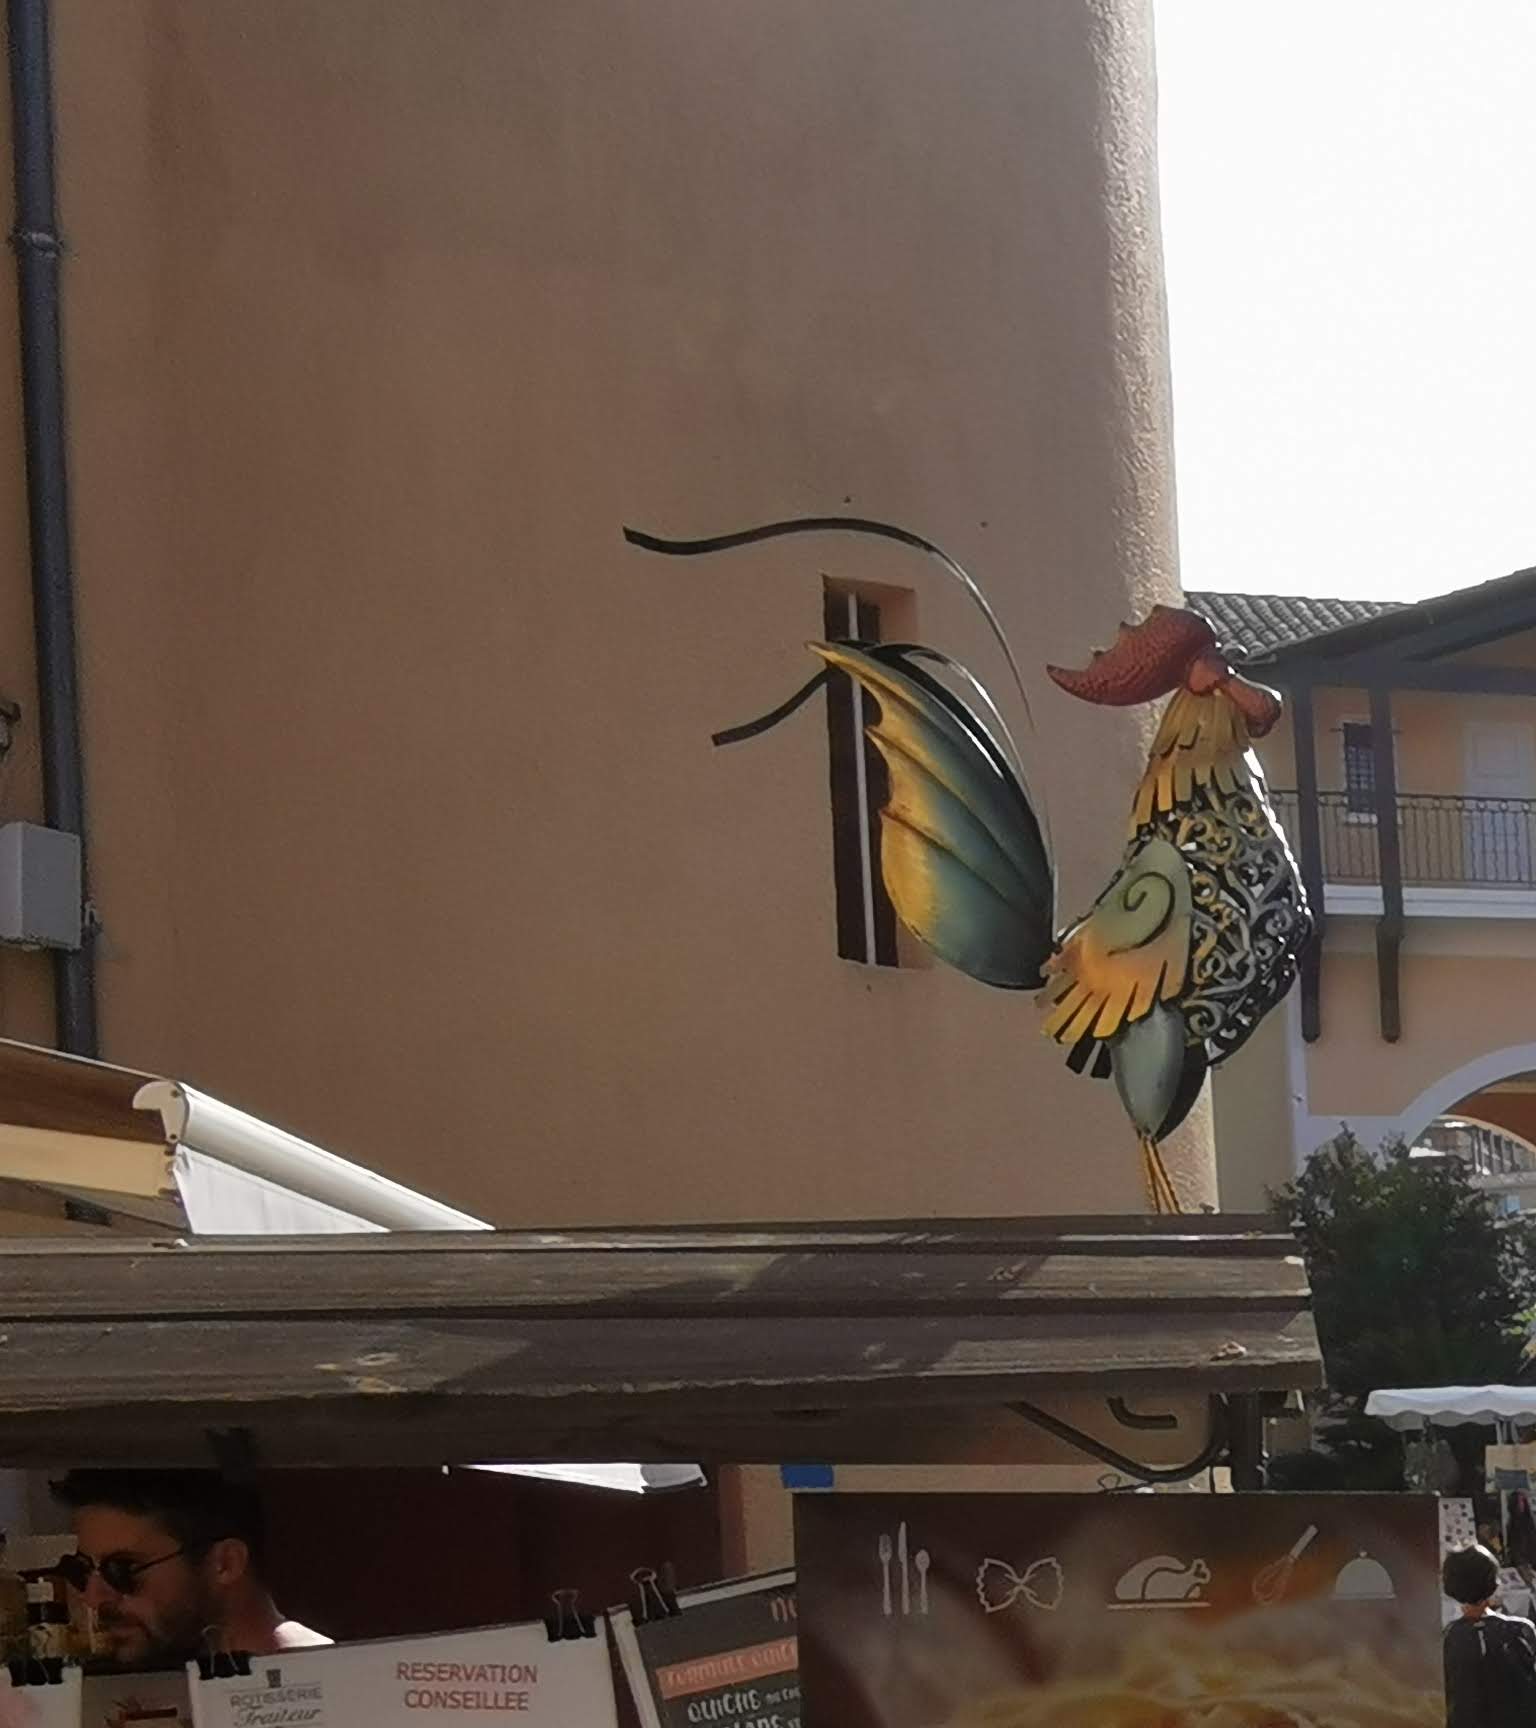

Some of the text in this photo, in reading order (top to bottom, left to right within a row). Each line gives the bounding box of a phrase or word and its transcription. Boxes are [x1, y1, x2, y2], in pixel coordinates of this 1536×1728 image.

[396, 1662, 539, 1684] RESERVATION
[230, 1687, 323, 1709] ROTISSERIE
[404, 1688, 530, 1712] CONSEILLEE
[688, 1690, 761, 1723] QUICHE
